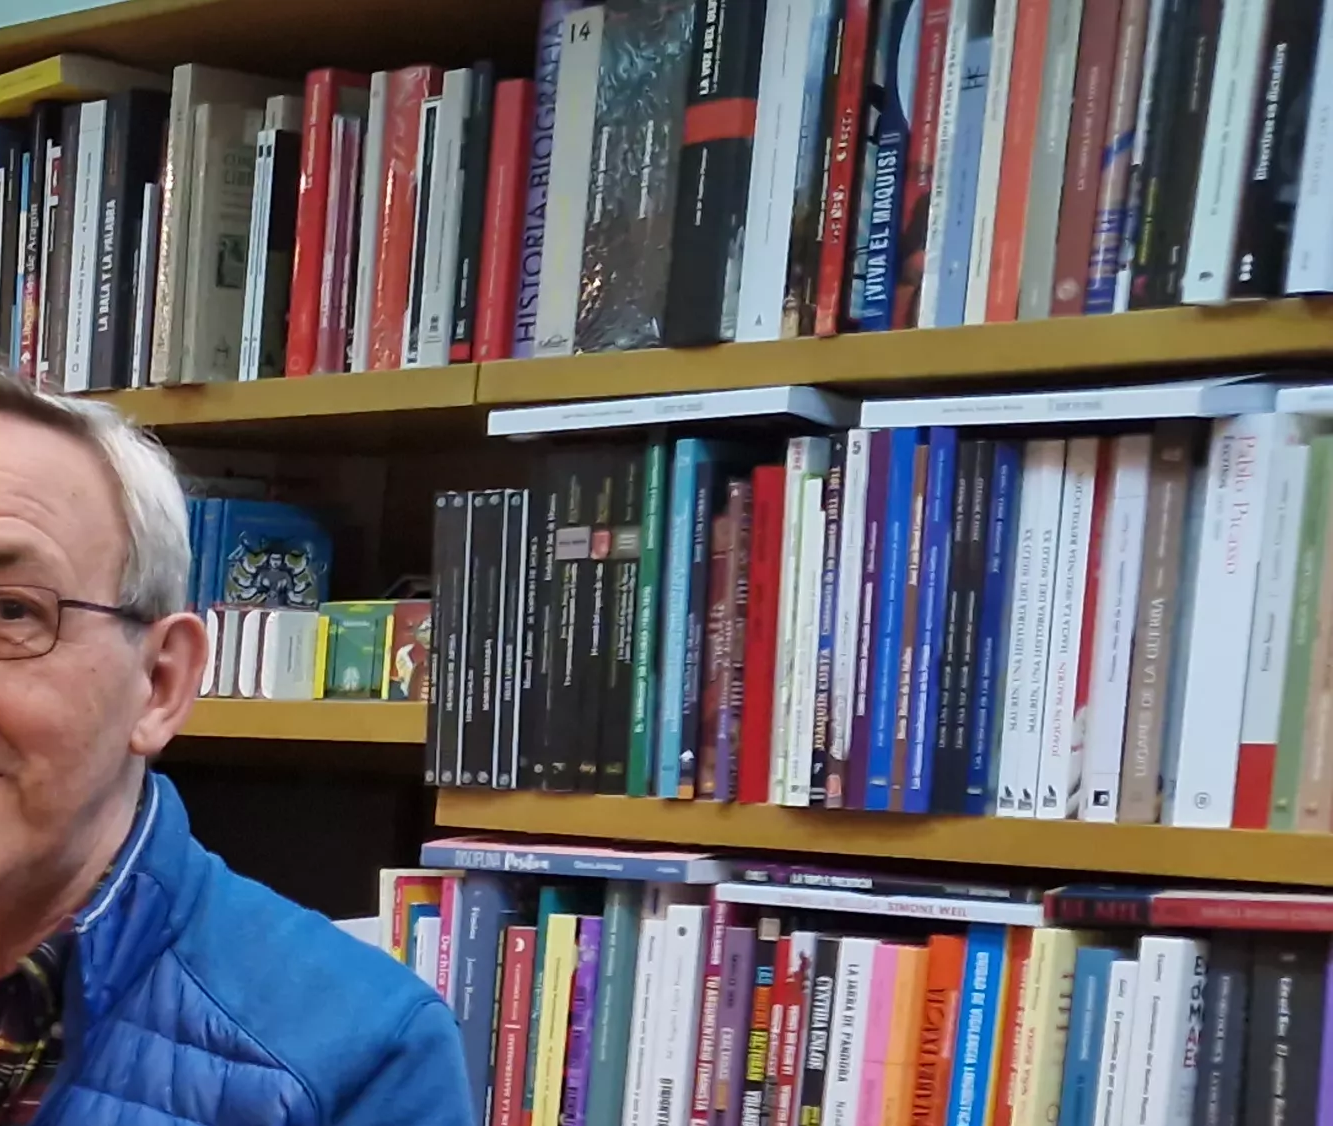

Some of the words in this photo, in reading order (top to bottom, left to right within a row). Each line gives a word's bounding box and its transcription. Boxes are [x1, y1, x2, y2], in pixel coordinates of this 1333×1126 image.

[569, 21, 592, 42] 14
[872, 149, 899, 225] MAQUIS!
[26, 203, 41, 251] Aragón
[101, 199, 118, 252] PALABRA
[869, 225, 889, 250] EL
[26, 258, 36, 272] de
[100, 271, 111, 281] Y
[101, 253, 113, 269] LA
[866, 255, 887, 303] ¡VIVA
[20, 273, 35, 345] Libertarios
[97, 284, 111, 313] BALA
[96, 315, 109, 332] LA
[1068, 471, 1085, 546] REVOLUCIÓN
[1023, 527, 1034, 542] XX
[1041, 529, 1053, 543] XX
[1021, 545, 1033, 578] SIGLO
[1039, 546, 1052, 579] SIGLO
[1064, 548, 1078, 600] SEGUNDA
[1018, 580, 1030, 602] DEL
[1036, 581, 1049, 603] DEL
[1062, 601, 1073, 617] LA
[1013, 604, 1028, 657] HISTORIA
[1032, 605, 1046, 659] HISTORIA
[1058, 619, 1071, 654] HACIA
[1146, 597, 1165, 660] GUERRA
[817, 648, 831, 690] COSTA
[1144, 664, 1157, 684] LA
[1141, 688, 1155, 708] DE
[1135, 710, 1153, 777] LUGARES
[440, 934, 451, 952] De
[847, 963, 860, 976] LA
[810, 975, 833, 1030] CYNTHIA
[843, 978, 859, 1013] JARRA
[970, 992, 985, 1006] DE
[842, 1014, 855, 1029] DE
[963, 1007, 984, 1065] VIGILANCIA
[807, 1030, 828, 1070] ENLOE
[836, 1031, 853, 1083] PANDORA
[694, 1061, 712, 1111] FEMINISTA
